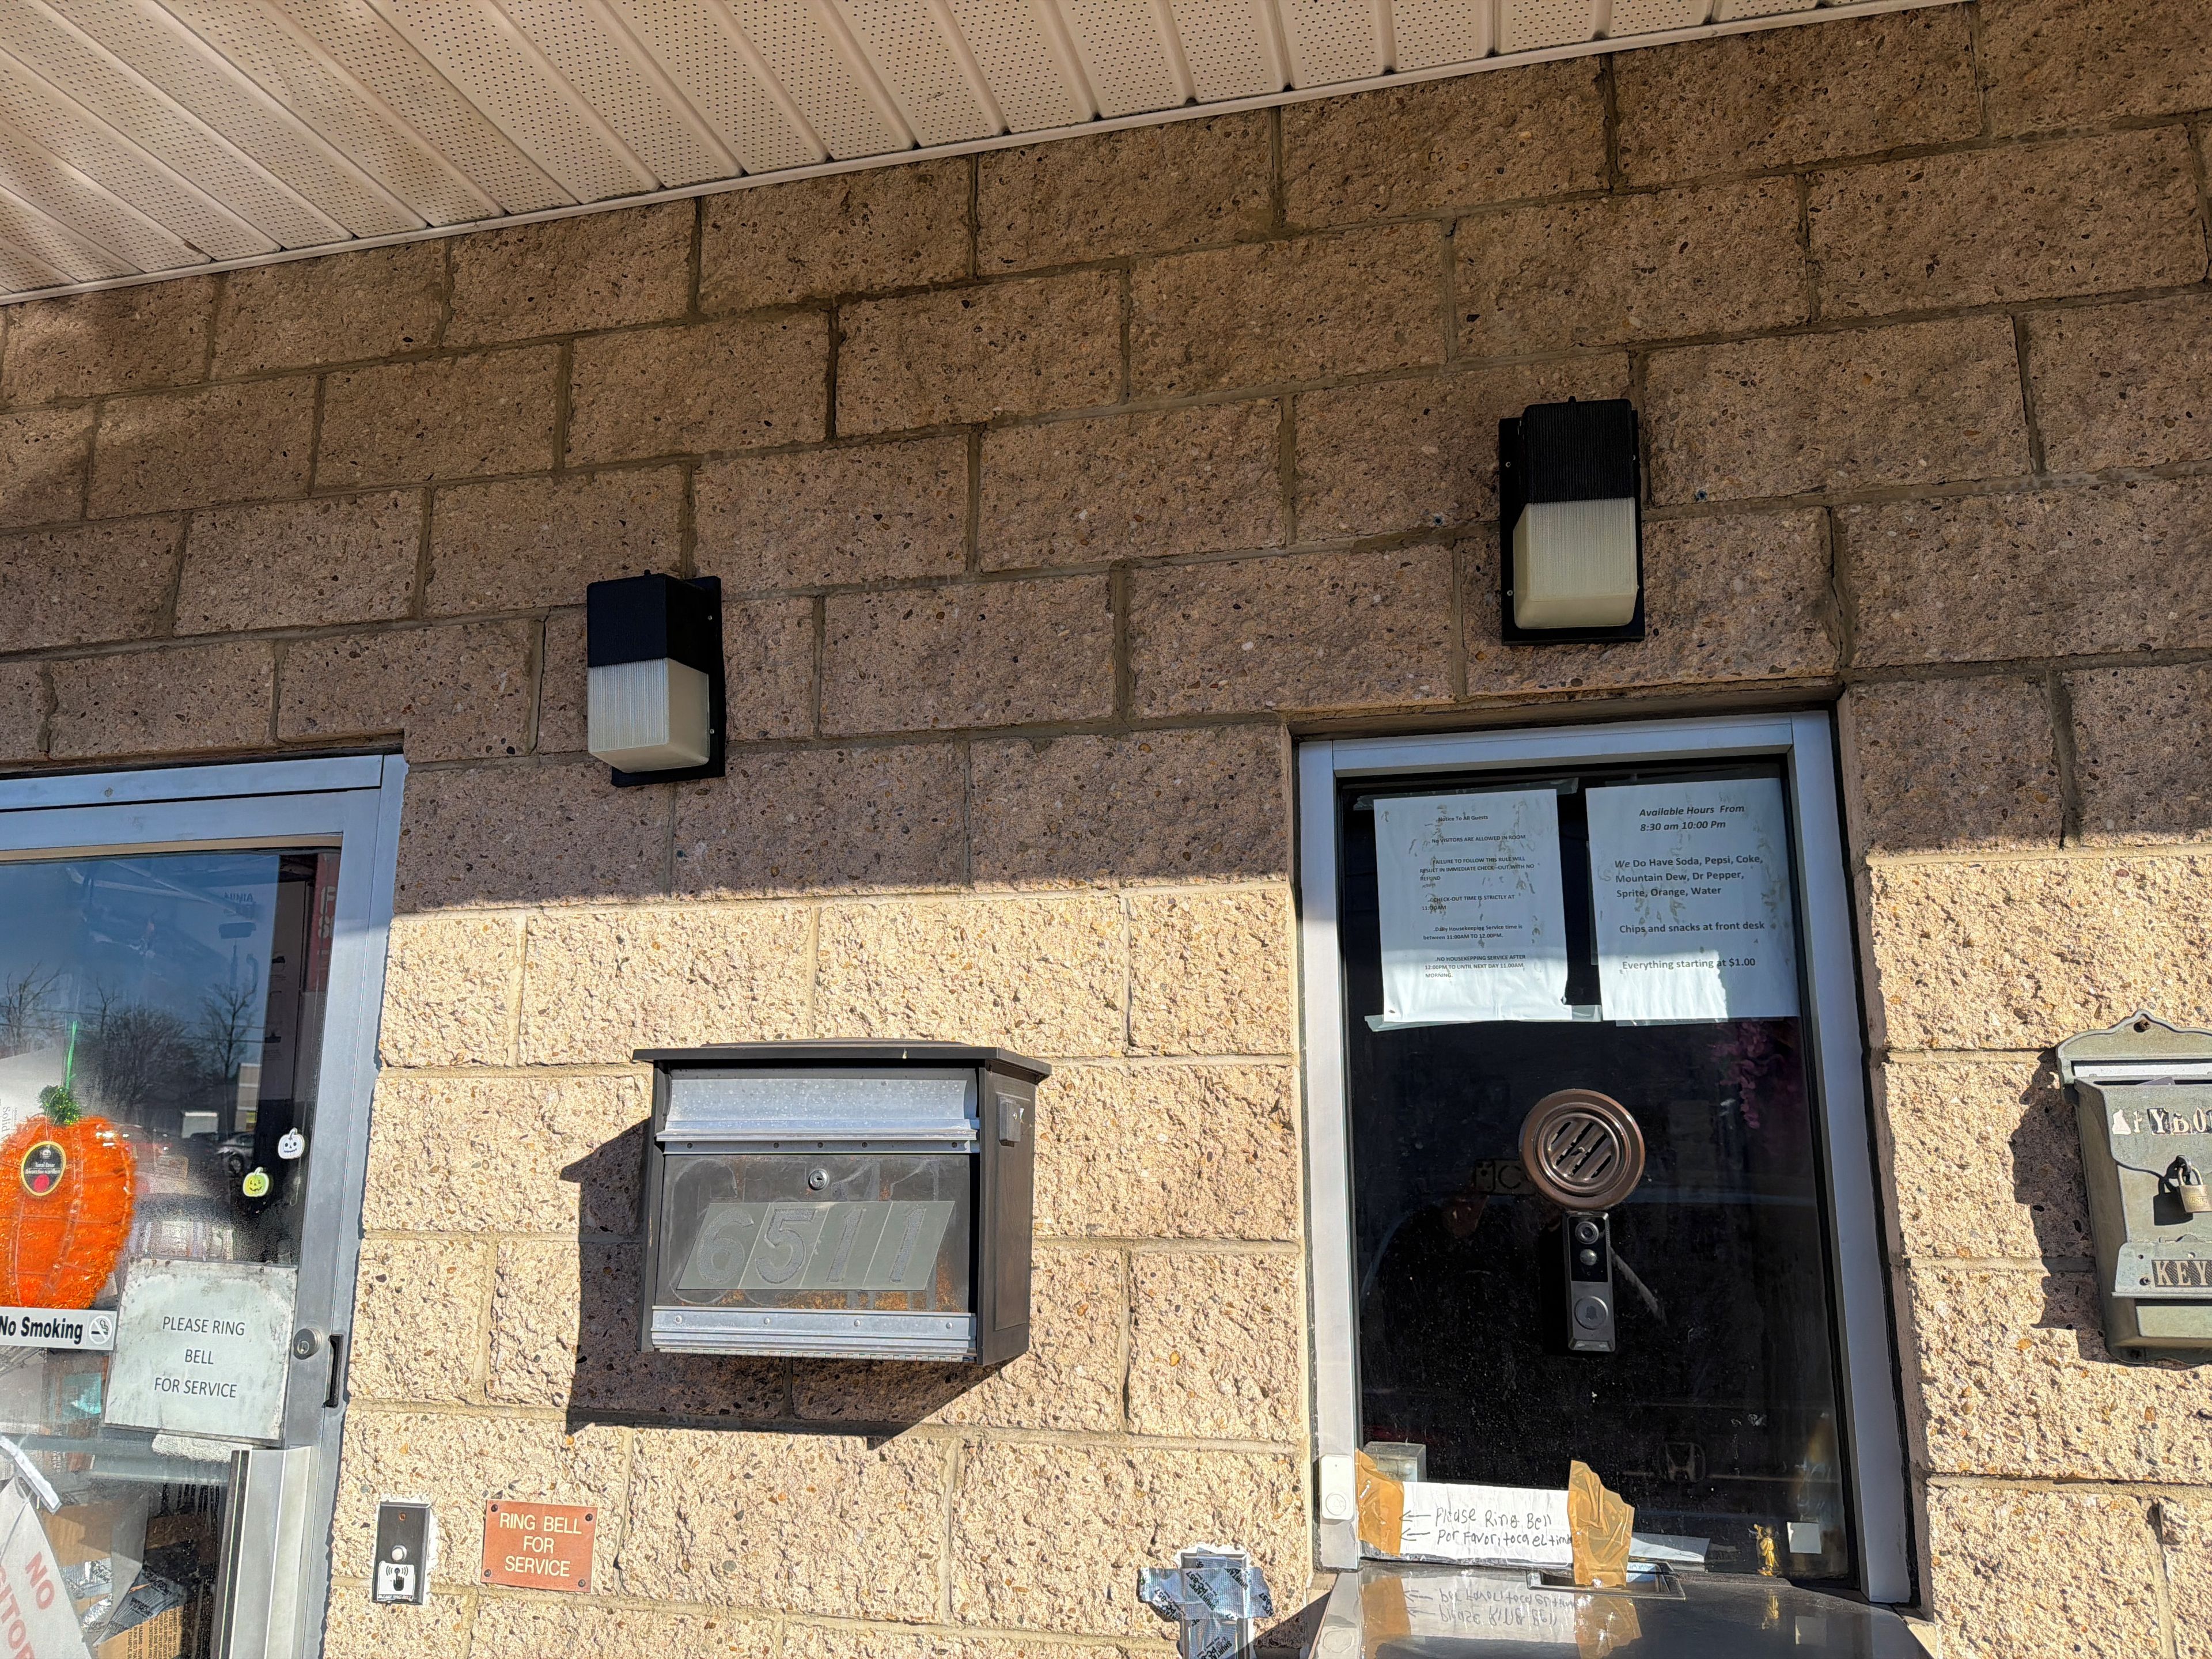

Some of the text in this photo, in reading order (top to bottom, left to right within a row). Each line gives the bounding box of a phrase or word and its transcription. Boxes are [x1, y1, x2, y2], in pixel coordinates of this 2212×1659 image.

[1639, 805, 1745, 817] Available Hours From
[1640, 822, 1661, 832] 8:30
[1682, 821, 1709, 830] 10:00
[1711, 820, 1726, 828] Pm
[1615, 855, 1763, 868] We Do Have Soda, Pepsi, Coke,
[1616, 870, 1744, 883] Mountain Dew, Dr Pepper,
[1616, 887, 1721, 899] Sprite, Orange, Water
[1619, 925, 1646, 935] Chips
[1648, 924, 1666, 933] and
[1668, 923, 1700, 932] snacks
[1715, 922, 1740, 930] front
[1743, 921, 1765, 930] desk
[1622, 960, 1674, 971] Everything
[1676, 959, 1714, 969] starting
[1729, 958, 1755, 968] $1.00
[696, 1206, 927, 1284] 6511
[2154, 1260, 2209, 1286] KEY
[0, 1316, 84, 1345] No Smoking
[162, 1316, 245, 1337] PLEASE RING
[184, 1349, 214, 1365] BELL
[154, 1377, 237, 1399] FOR SERVICE
[499, 1512, 582, 1535] RING BELL
[1527, 1513, 1552, 1530] Bell
[523, 1536, 554, 1554] FOR
[505, 1555, 571, 1577] SERVICE
[25, 1551, 55, 1609] NO
